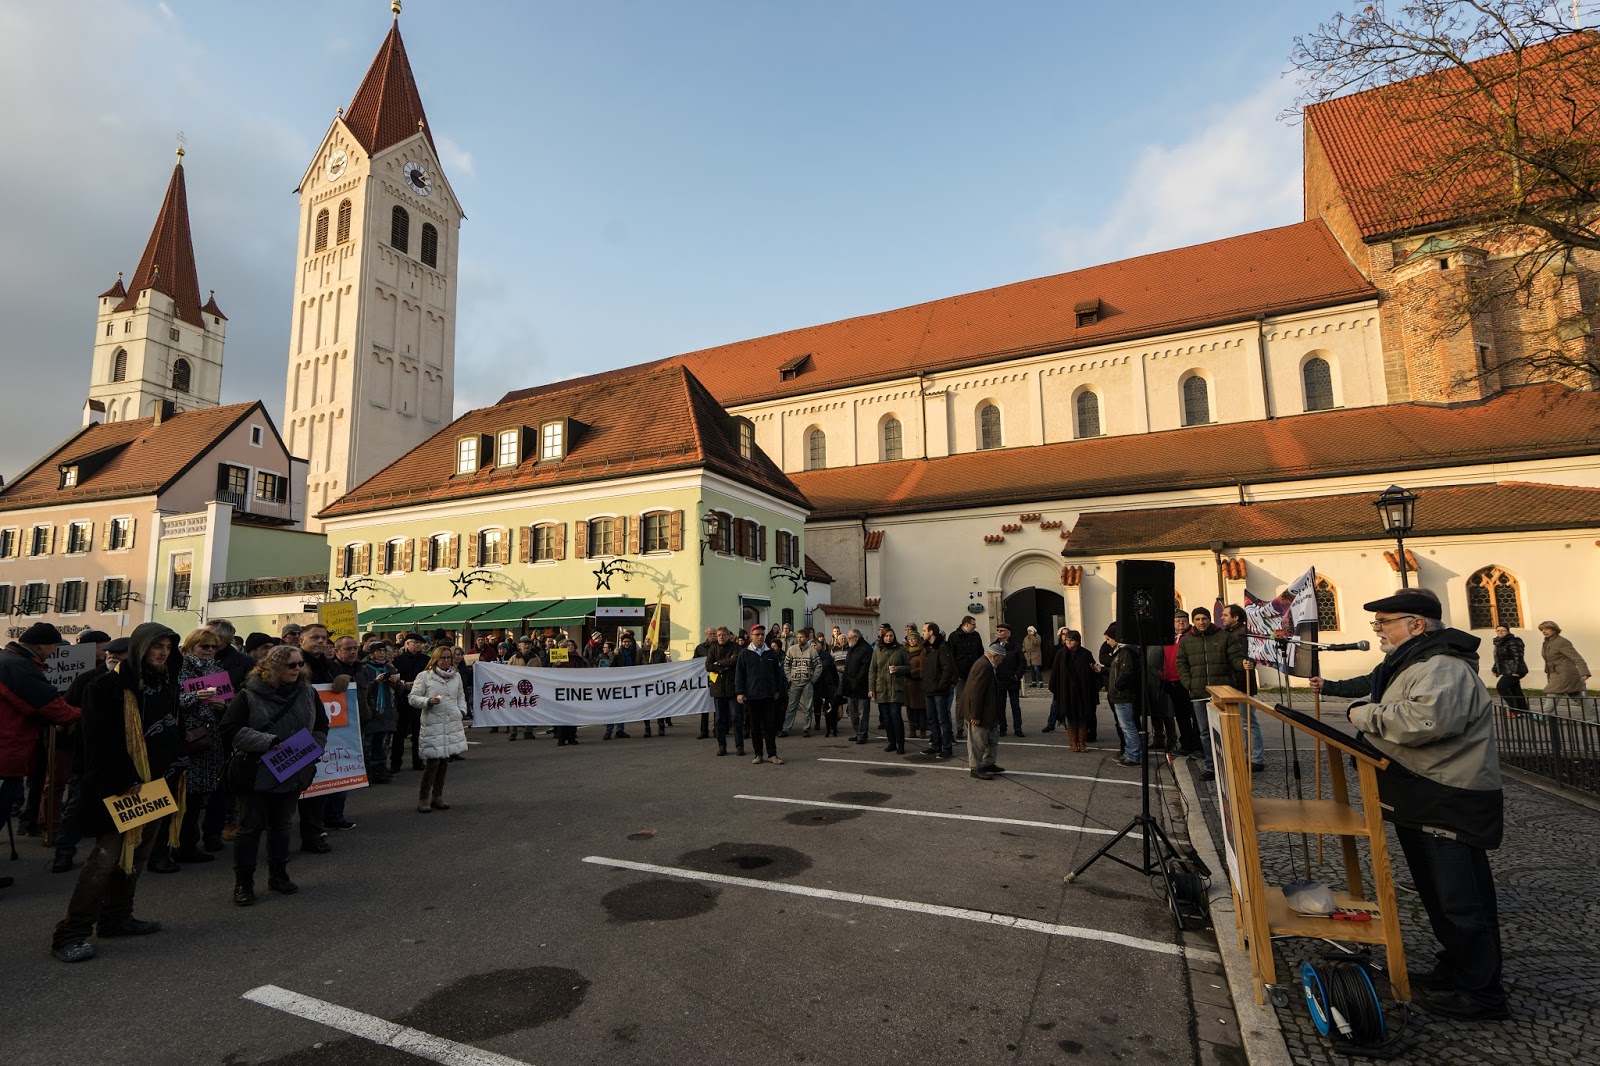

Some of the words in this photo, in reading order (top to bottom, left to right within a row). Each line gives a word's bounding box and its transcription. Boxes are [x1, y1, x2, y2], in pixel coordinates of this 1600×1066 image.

[45, 661, 86, 673] o-Nazis
[555, 688, 593, 701] EINE
[596, 685, 641, 701] WELT
[645, 680, 677, 697] FÜR
[269, 746, 294, 767] NEIN
[275, 742, 317, 773] RASSISMUS
[321, 747, 352, 763] CHTS
[112, 793, 142, 812] NON
[118, 796, 171, 823] RACISME
